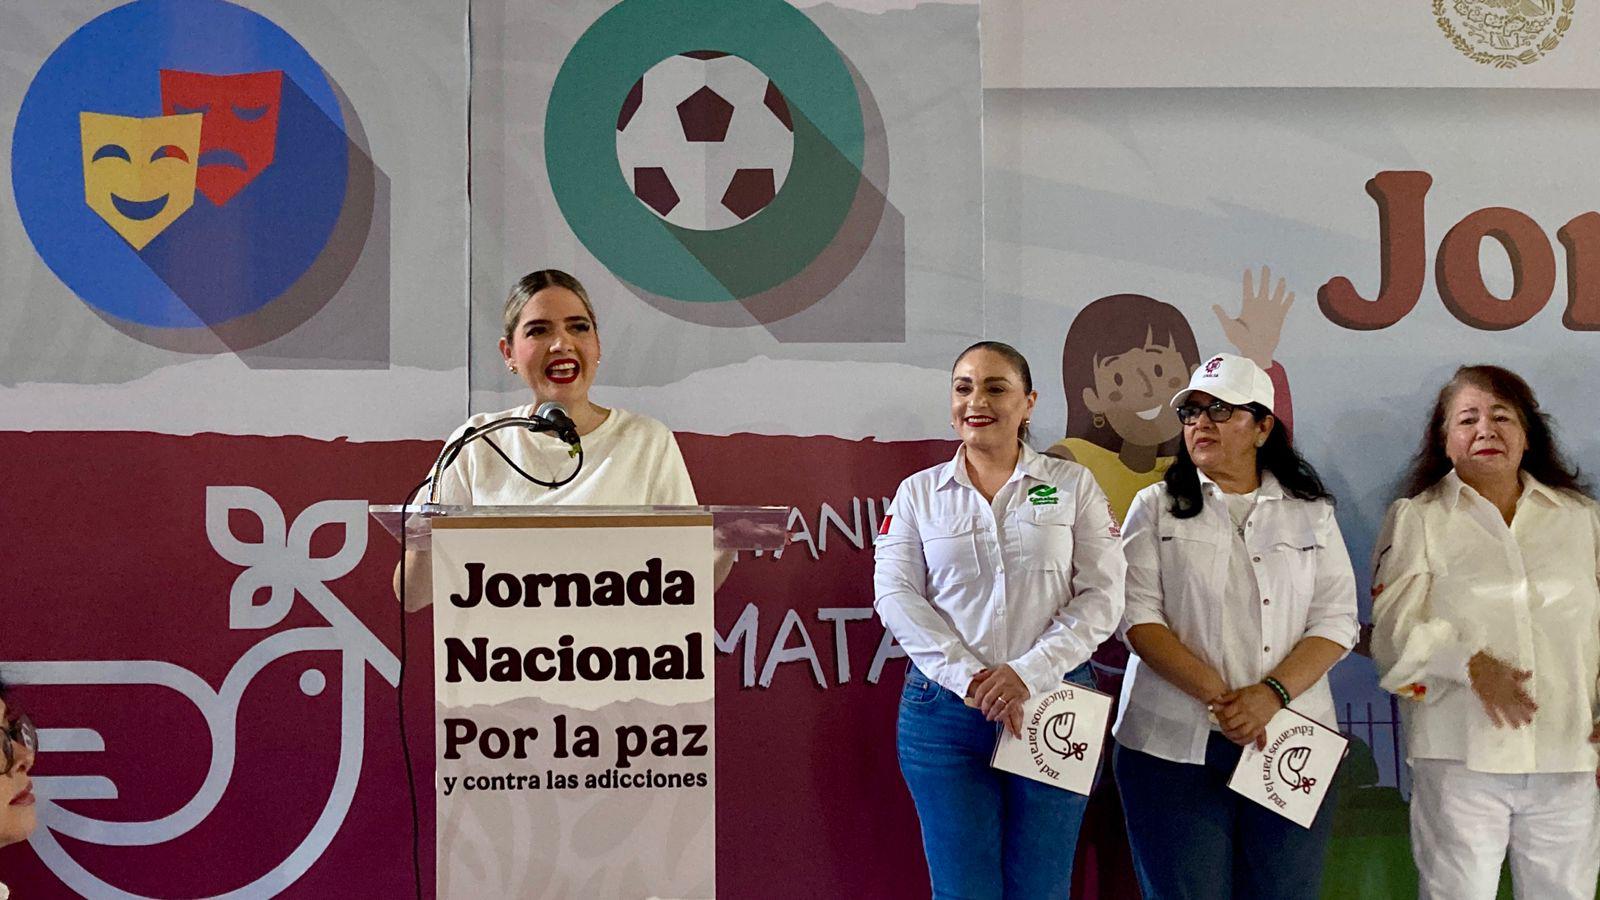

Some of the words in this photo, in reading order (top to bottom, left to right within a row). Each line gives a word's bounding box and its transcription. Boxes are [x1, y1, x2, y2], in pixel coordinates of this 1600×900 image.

[450, 558, 695, 608] Jornada
[444, 632, 706, 682] Nacional
[1031, 689, 1074, 726] Educamos
[443, 718, 539, 759] Por
[553, 714, 600, 758] la
[615, 723, 708, 768] paz
[1026, 727, 1039, 754] para
[1268, 725, 1315, 755] Educamos
[1033, 754, 1044, 766] la
[1039, 764, 1061, 780] paz
[1262, 754, 1273, 781] para
[443, 775, 458, 796] y
[463, 772, 541, 790] contra
[546, 770, 579, 789] las
[585, 768, 708, 788] adicciones
[1264, 781, 1274, 792] la
[1267, 792, 1287, 810] paz
